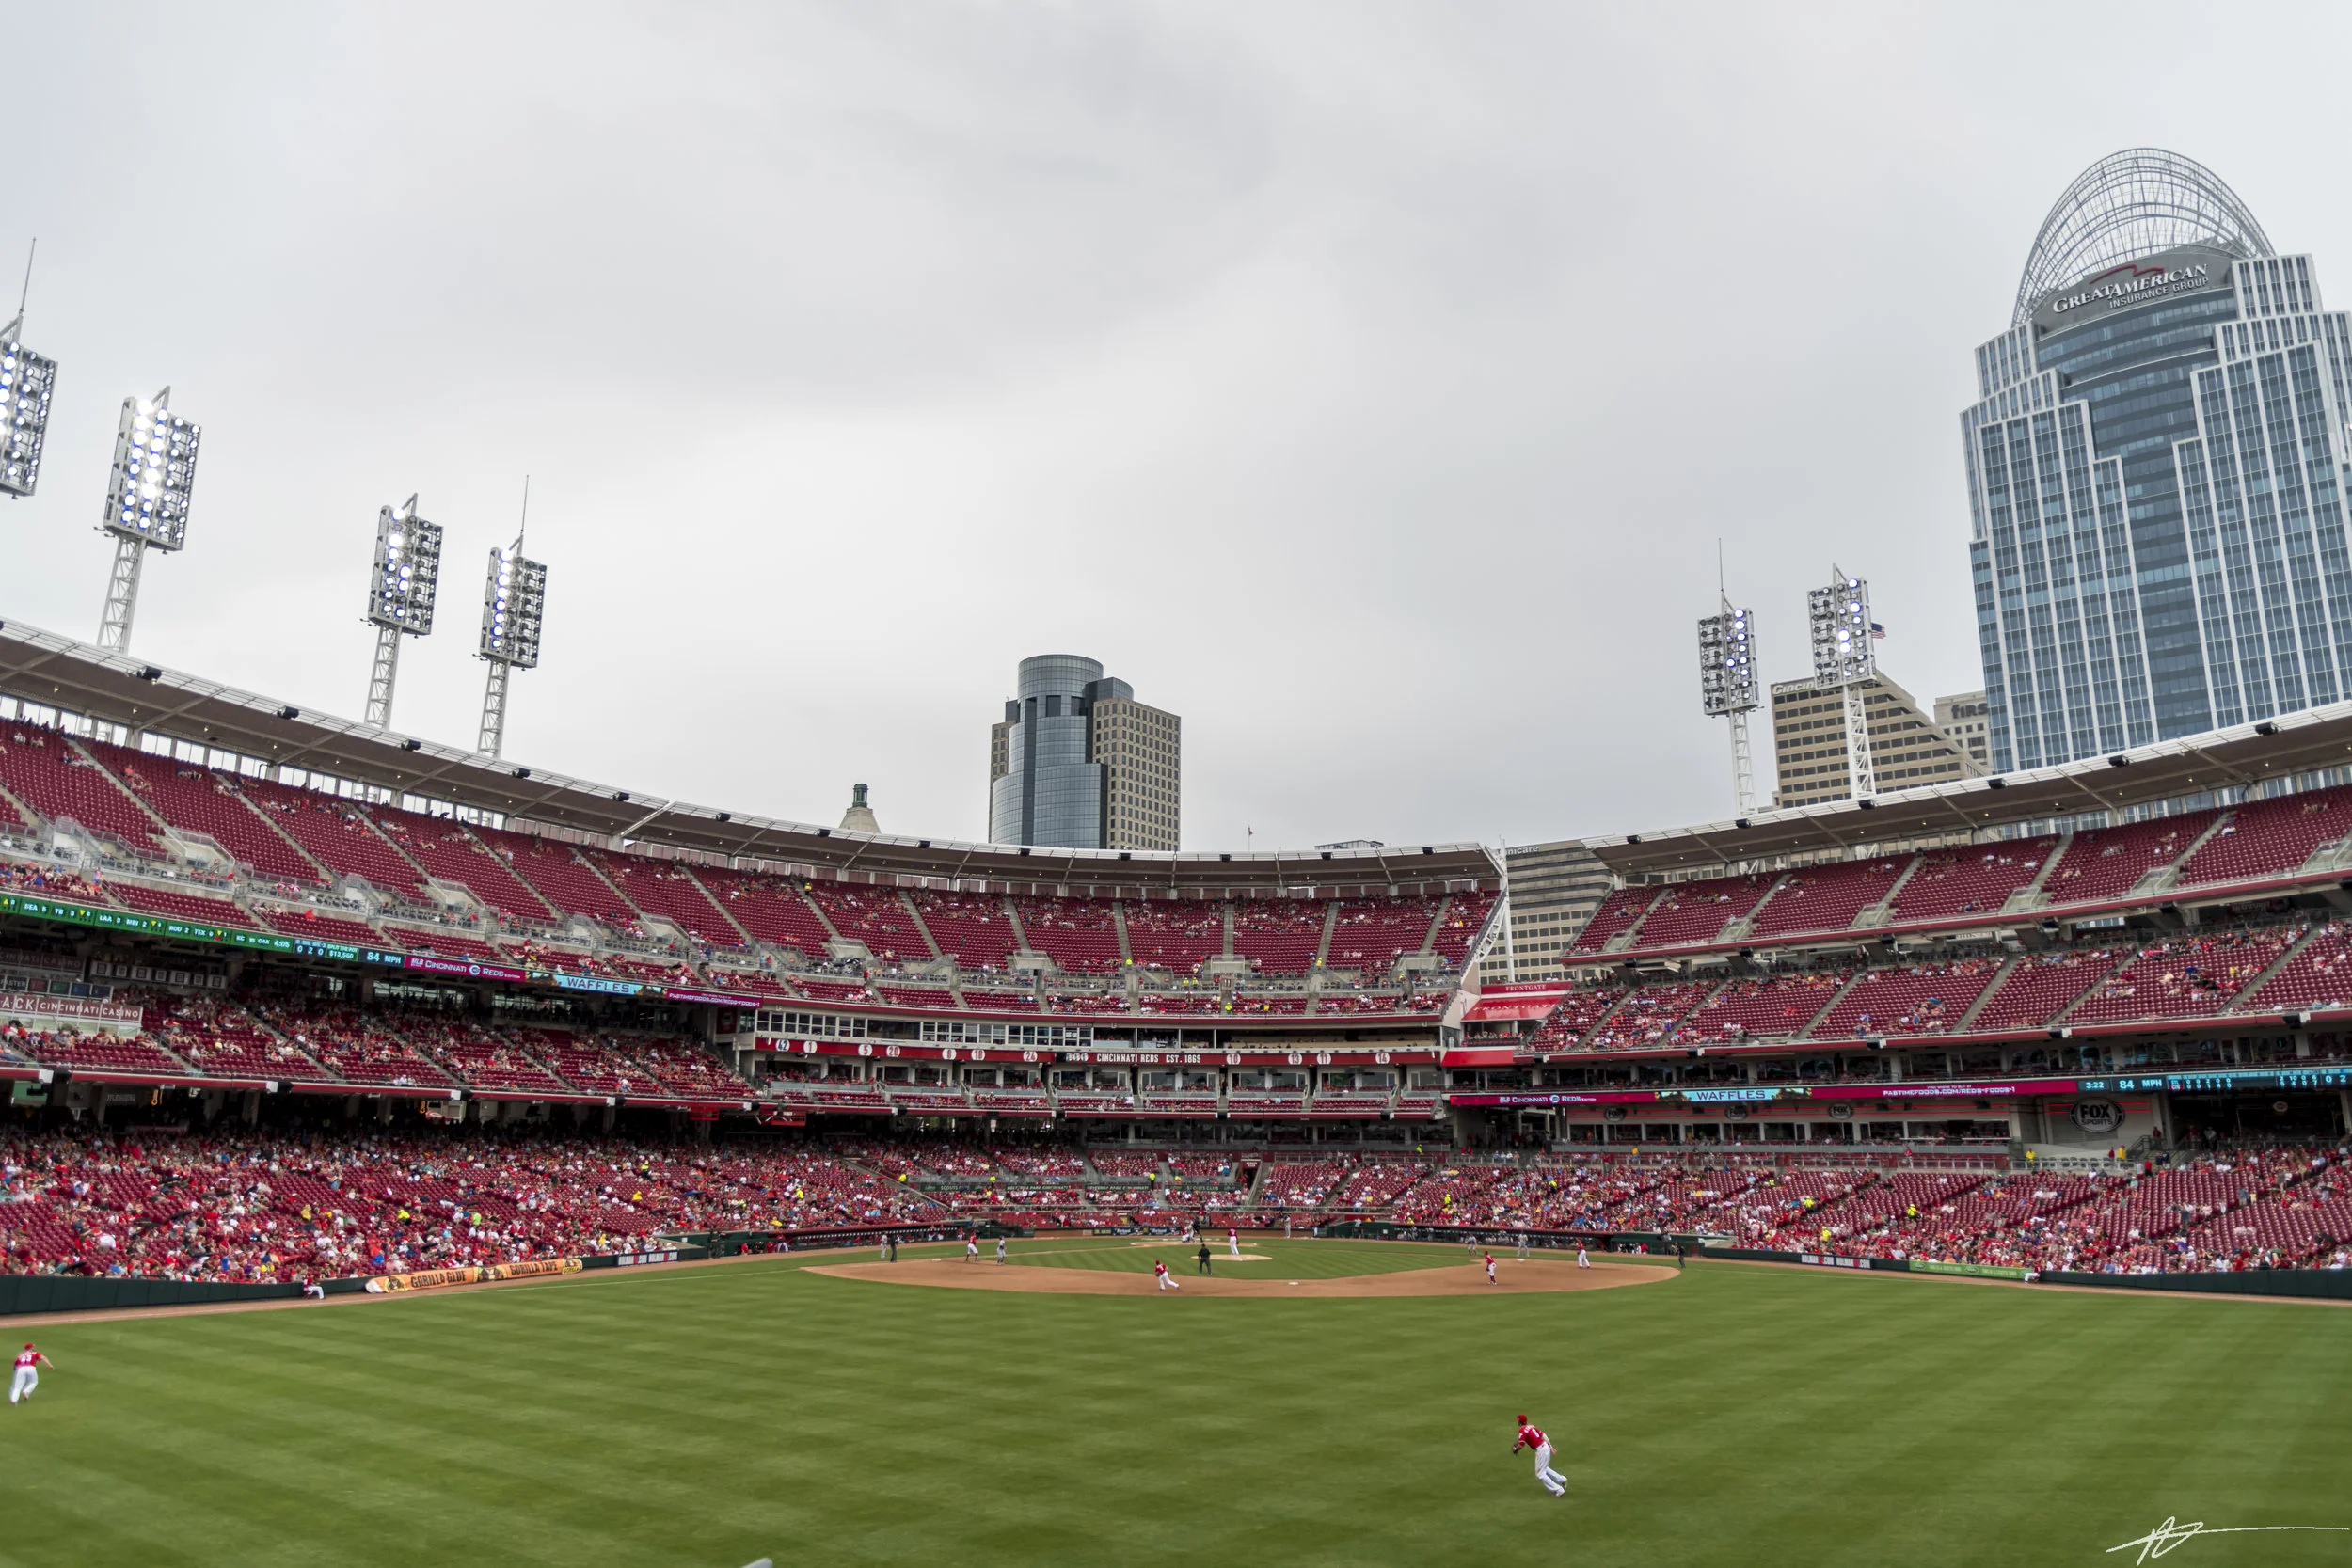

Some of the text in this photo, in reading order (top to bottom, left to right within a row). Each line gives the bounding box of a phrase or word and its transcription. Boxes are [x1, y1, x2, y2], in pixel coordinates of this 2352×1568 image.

[2109, 277, 2209, 309] INSURANCE GROUP
[194, 928, 206, 937] TEX
[274, 940, 290, 949] 4:05
[297, 945, 303, 954] 0
[308, 946, 313, 955] 2
[366, 951, 401, 964] 84 MPH
[482, 968, 504, 977] REDS
[567, 976, 630, 993] WAFFLES
[40, 1002, 99, 1014] CINCINNATI
[102, 1008, 139, 1018] CASINO
[777, 1039, 787, 1051] 42
[888, 1047, 899, 1057] 20
[1096, 1053, 1201, 1064] CINCINNATI REDS EST. 1869
[1229, 1054, 1239, 1064] 10
[1291, 1054, 1300, 1064] 13
[1377, 1053, 1388, 1064] 14
[2340, 1074, 2346, 1083] 2
[2086, 1081, 2104, 1089] 3:22
[2119, 1079, 2162, 1089] 84 MPH
[1696, 1089, 1766, 1100] WAFFLES
[1834, 1104, 1849, 1114] FOX
[2080, 1104, 2111, 1118] FOX
[509, 1260, 559, 1275] GORILLA TAPE
[410, 1270, 467, 1288] GORILLA GLUE
